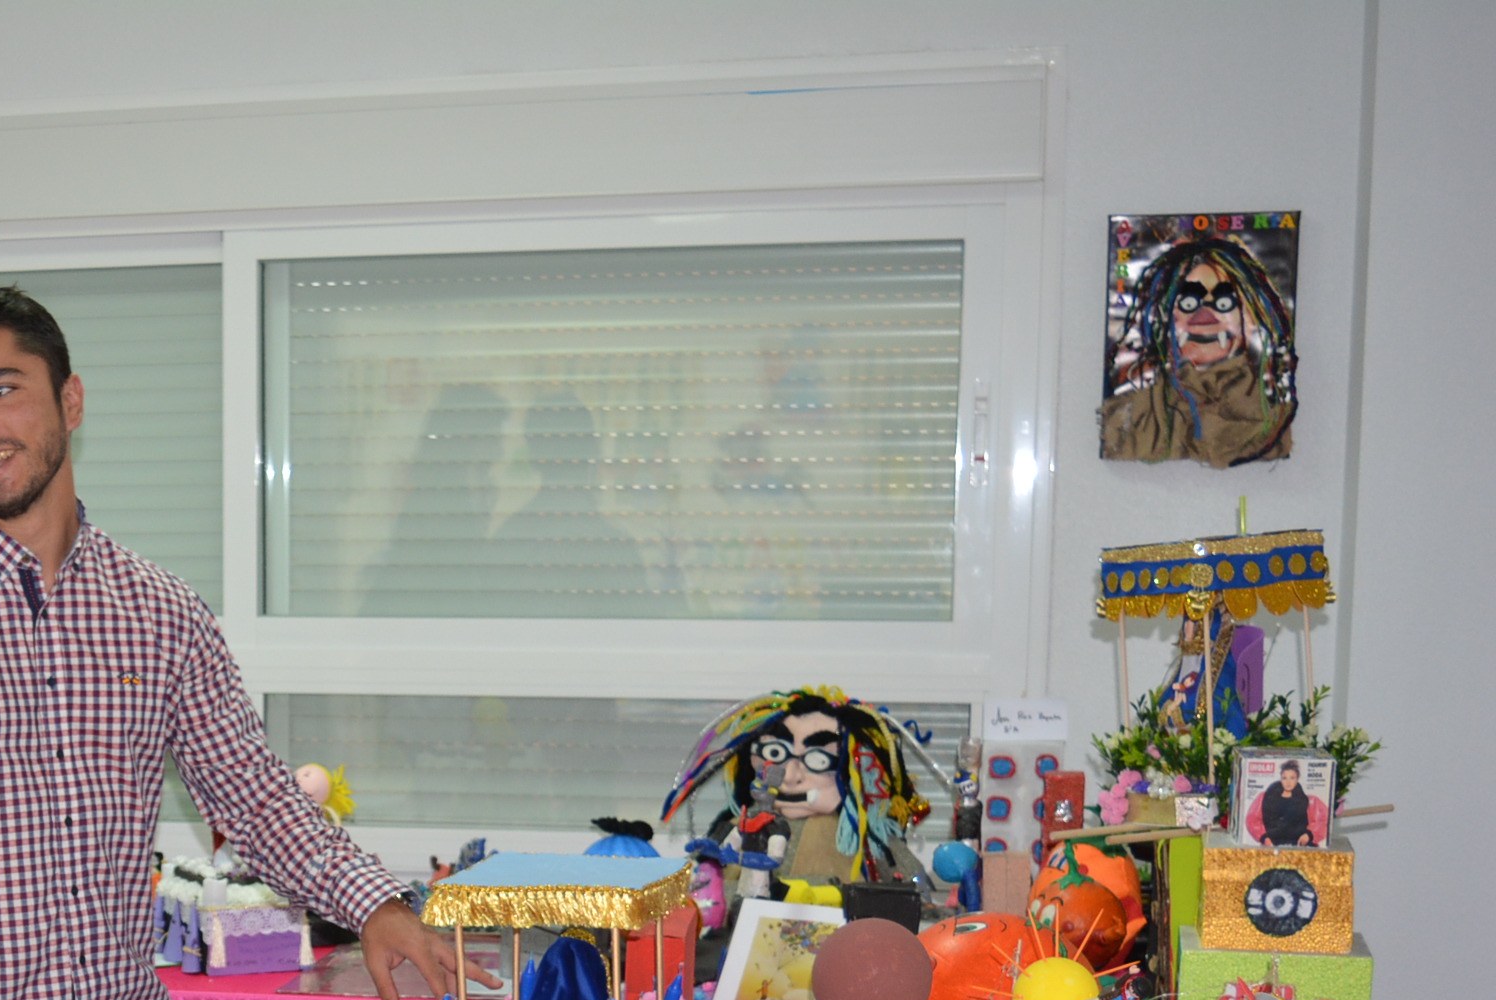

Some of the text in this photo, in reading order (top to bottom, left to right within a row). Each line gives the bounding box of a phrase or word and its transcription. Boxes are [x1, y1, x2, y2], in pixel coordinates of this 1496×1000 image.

[1179, 213, 1296, 231] NO SE RIA
